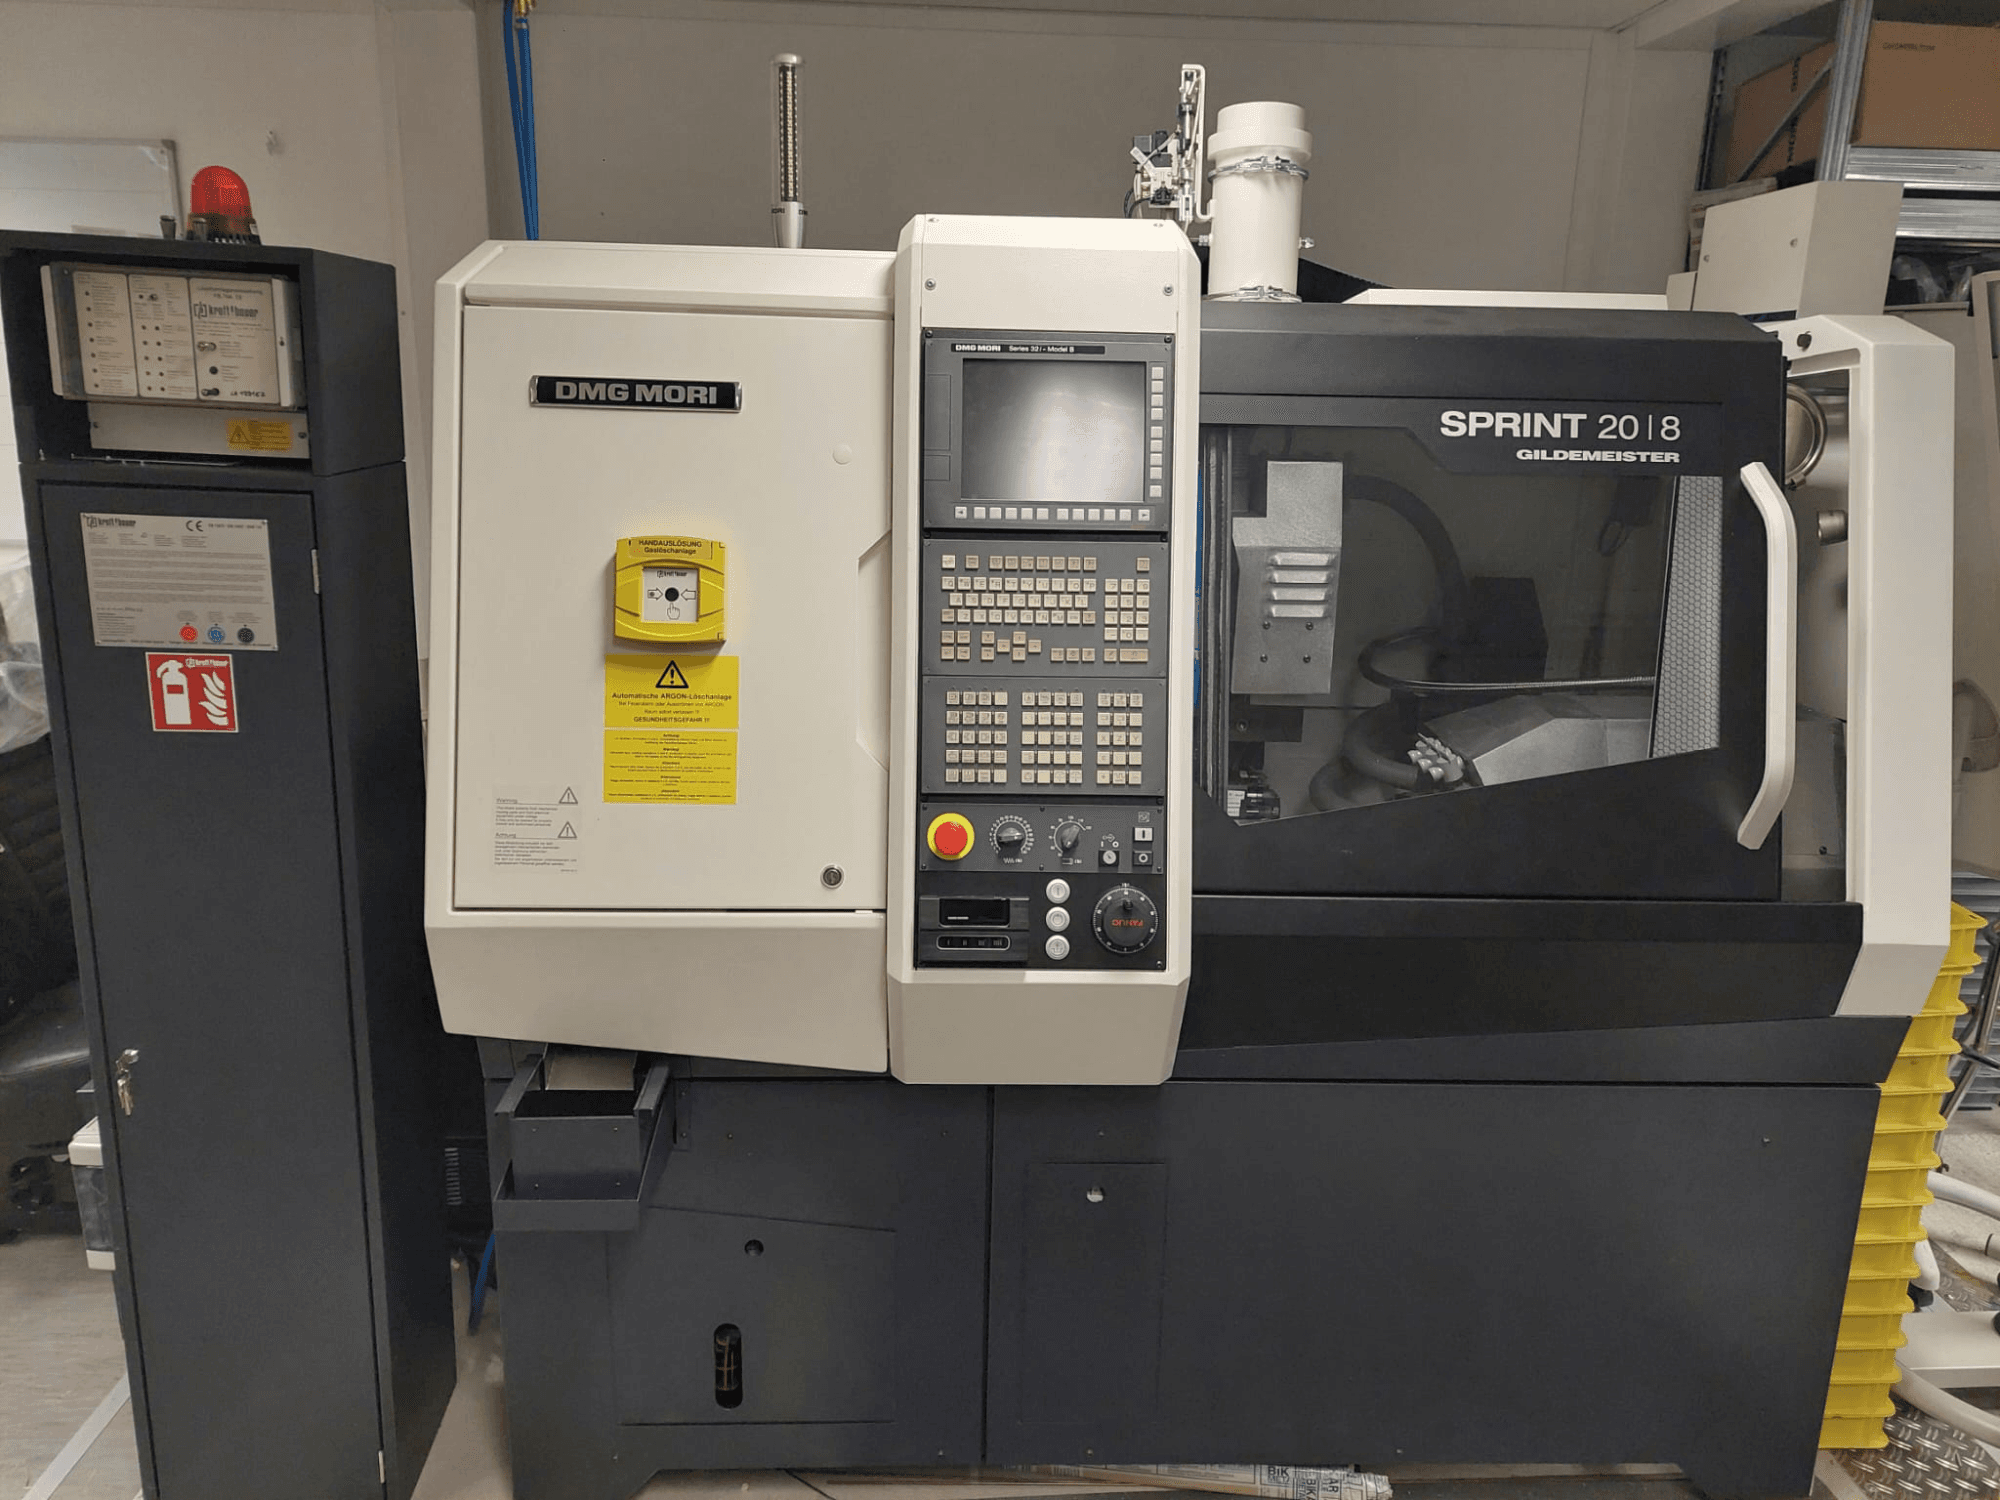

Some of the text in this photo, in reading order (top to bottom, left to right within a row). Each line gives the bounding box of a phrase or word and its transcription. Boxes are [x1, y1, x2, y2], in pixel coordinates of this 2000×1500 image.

[955, 344, 977, 352] DMG
[1008, 344, 1029, 352] Series
[555, 381, 717, 404] DMG MORI
[1440, 410, 1588, 438] SPRINT
[1516, 449, 1680, 463] GILDEMEISTER
[638, 538, 702, 548] HANDAUSLÖSUNG
[644, 546, 697, 555] Gaslöschanlage
